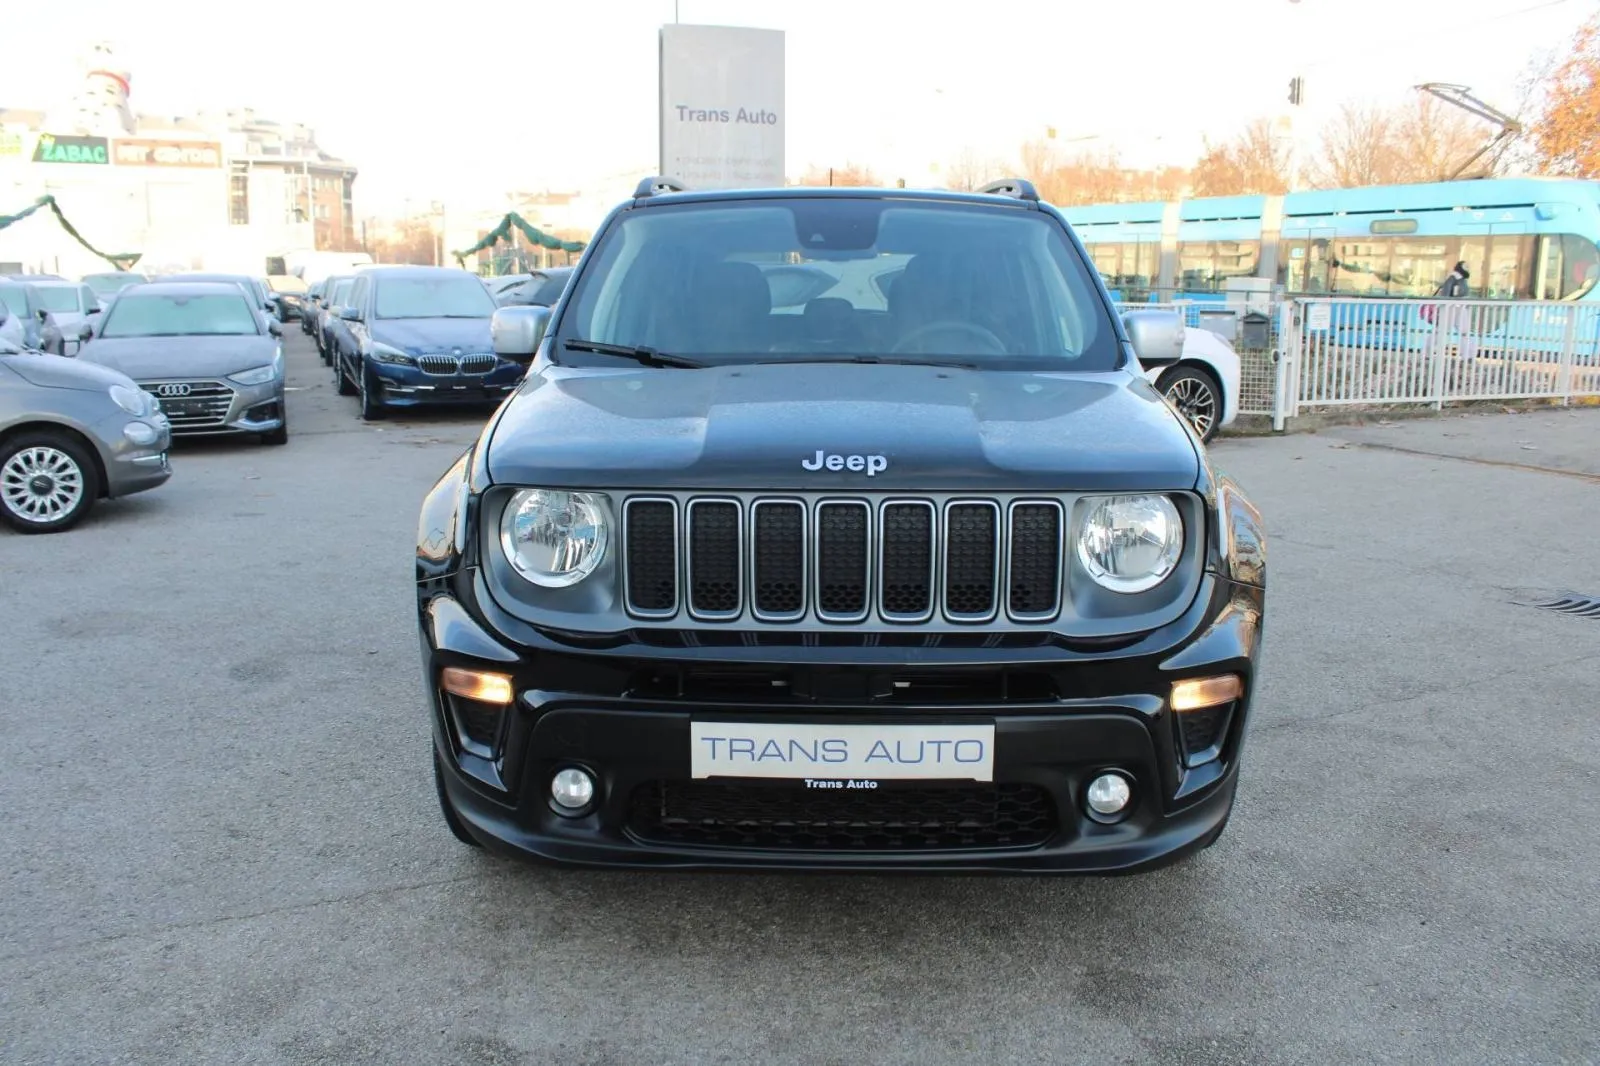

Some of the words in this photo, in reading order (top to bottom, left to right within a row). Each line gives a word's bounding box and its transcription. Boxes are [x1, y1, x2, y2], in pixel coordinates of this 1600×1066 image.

[675, 104, 730, 123] Trans
[735, 106, 778, 125] Auto
[801, 450, 888, 476] Jeep
[700, 736, 849, 763] TRANS
[864, 739, 985, 764] AUTO
[804, 778, 844, 789] Trans
[846, 779, 878, 790] Auto
